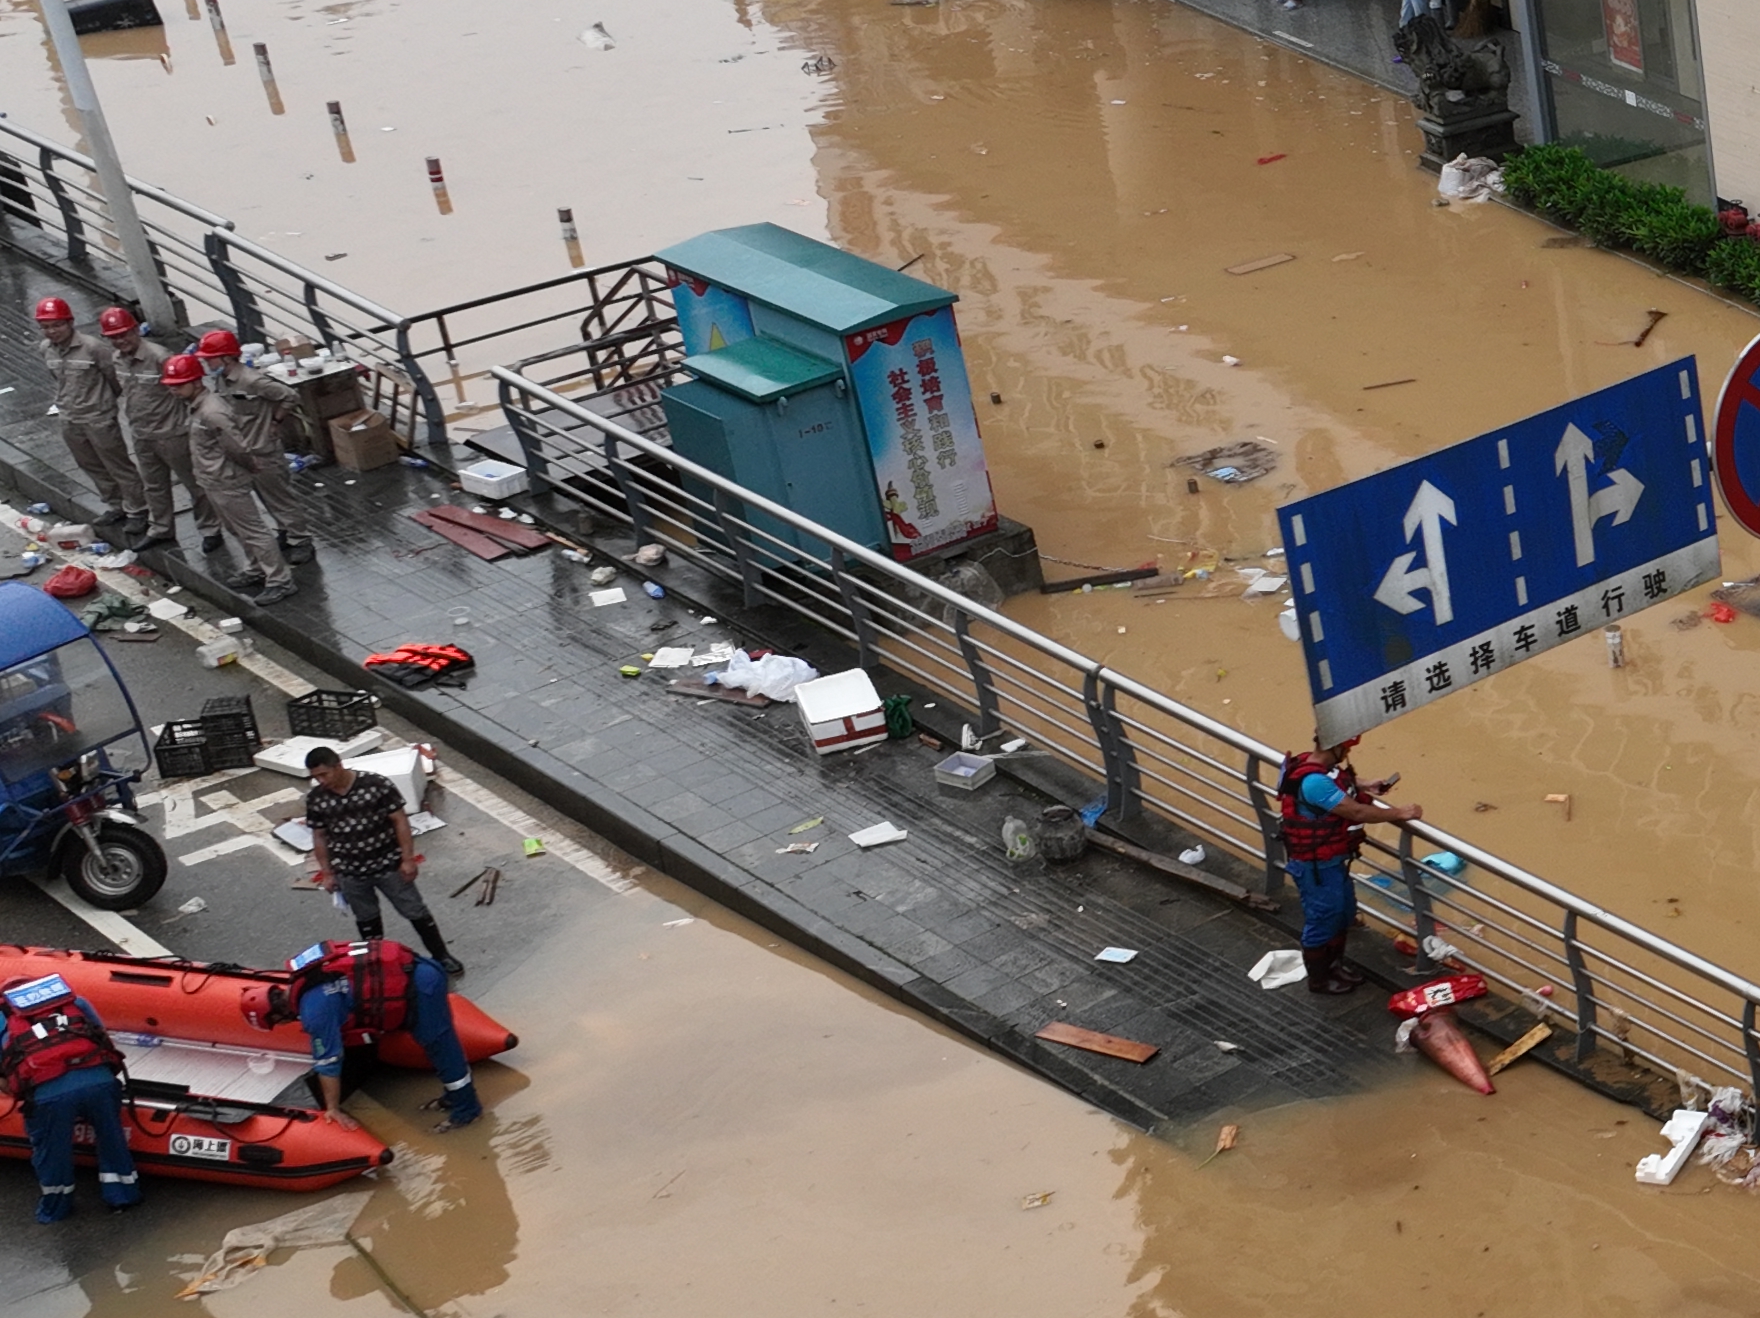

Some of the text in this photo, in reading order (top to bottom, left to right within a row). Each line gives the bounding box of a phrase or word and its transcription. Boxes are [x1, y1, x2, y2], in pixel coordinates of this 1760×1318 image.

[1381, 569, 1667, 713] 请选择车道行驶
